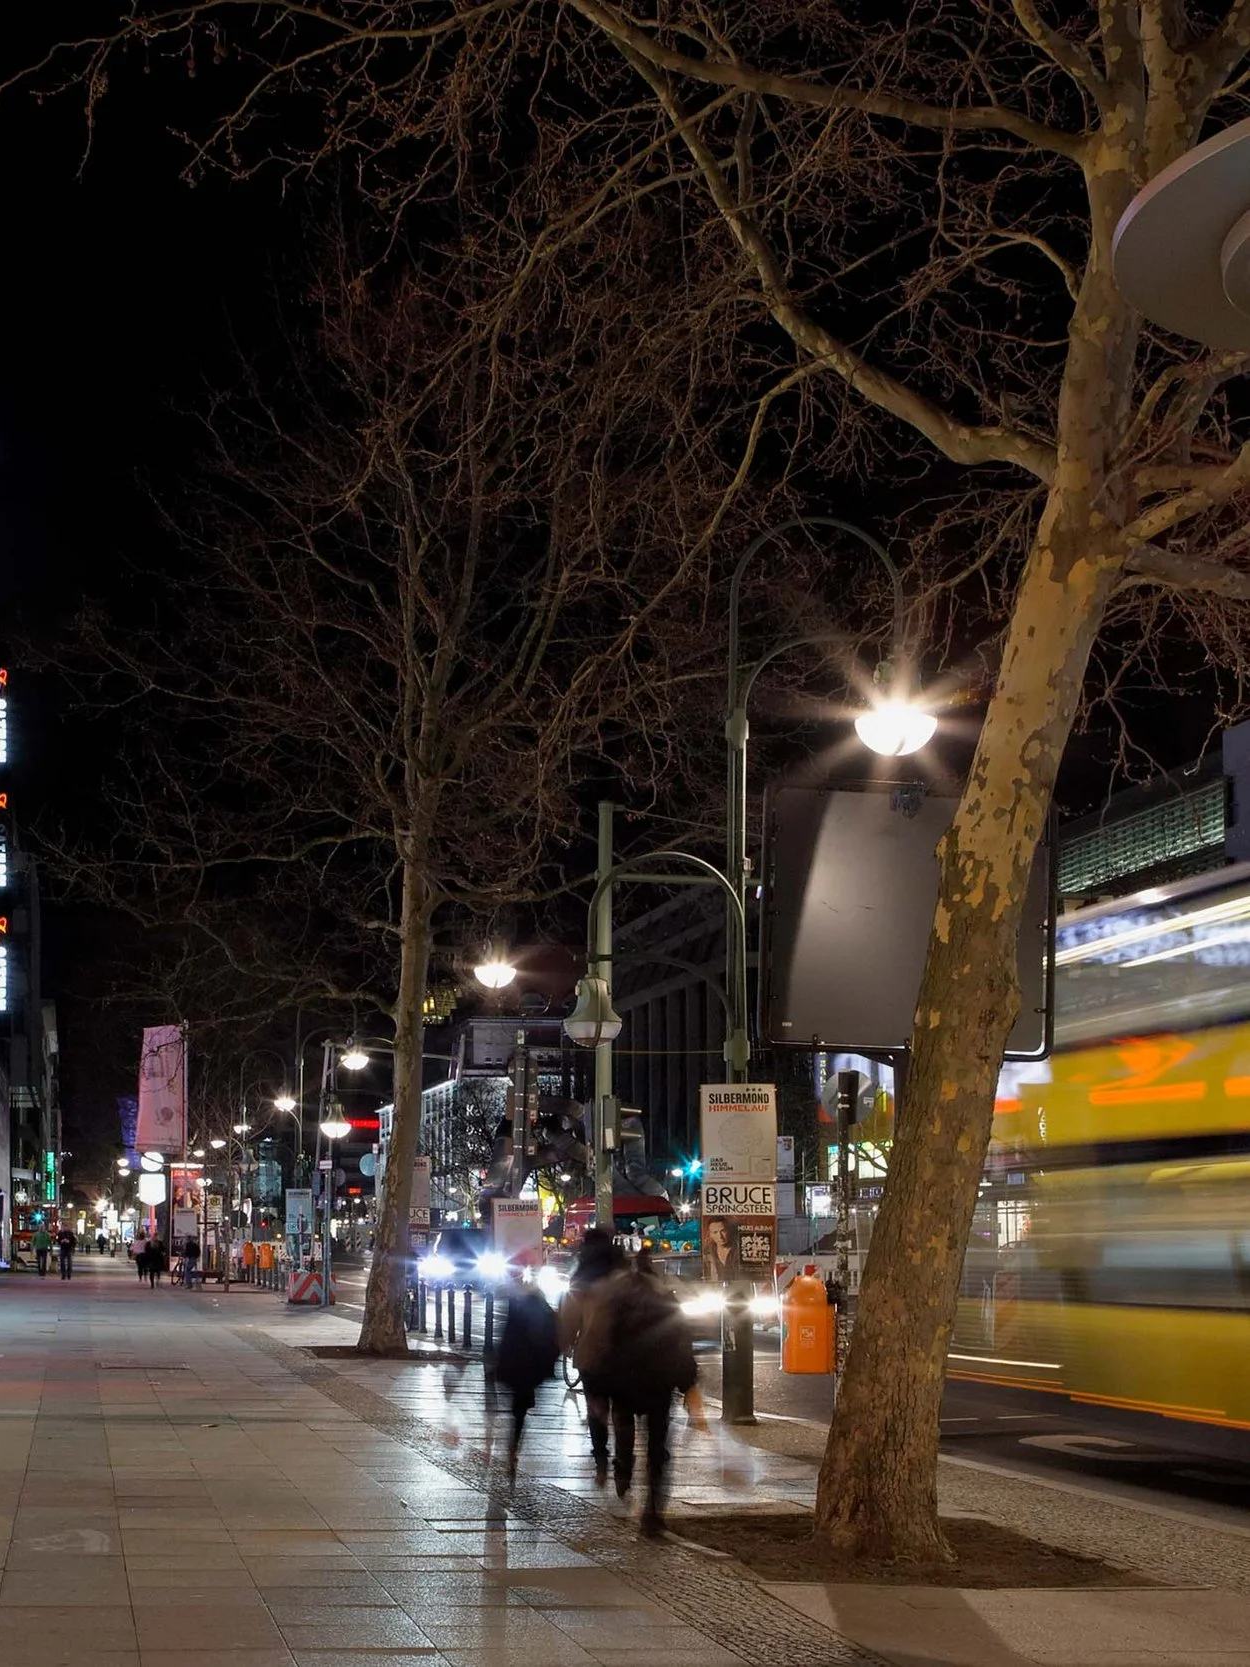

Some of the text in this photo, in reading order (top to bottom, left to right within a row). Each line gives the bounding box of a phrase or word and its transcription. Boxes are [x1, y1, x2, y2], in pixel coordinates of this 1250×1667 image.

[708, 1093, 770, 1105] SILBERMOND
[706, 1187, 772, 1205] BRUCE
[706, 1204, 773, 1214] SPRINGSTEEN
